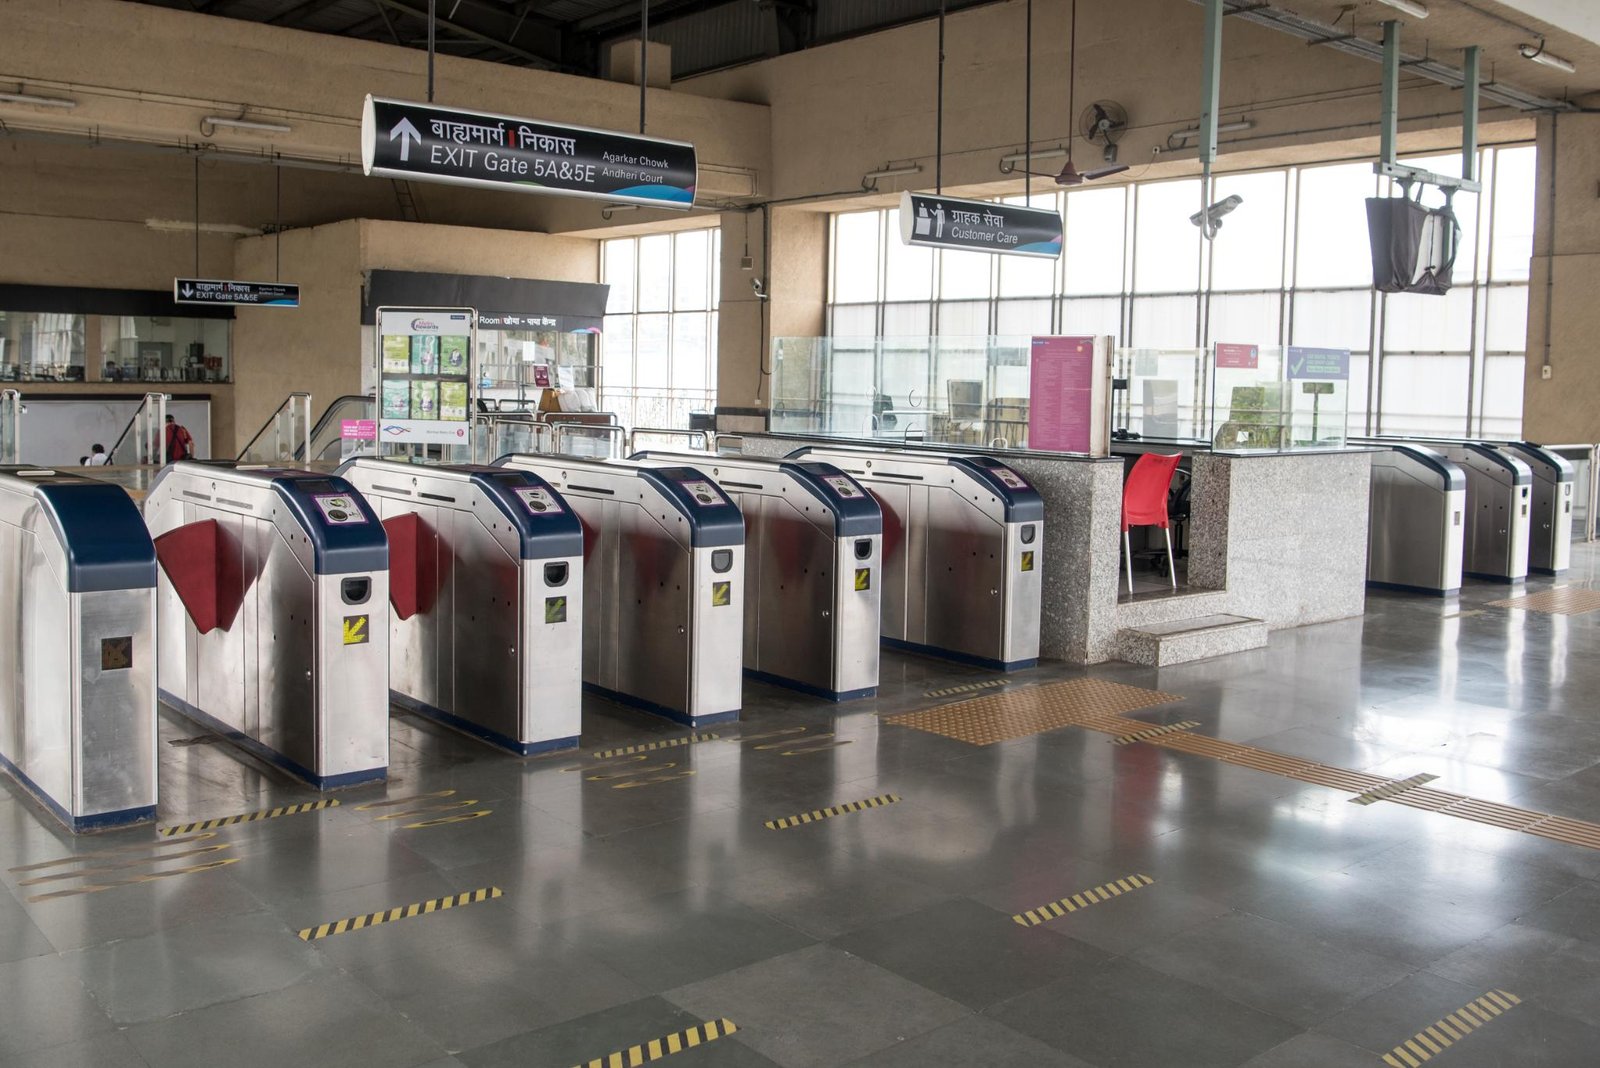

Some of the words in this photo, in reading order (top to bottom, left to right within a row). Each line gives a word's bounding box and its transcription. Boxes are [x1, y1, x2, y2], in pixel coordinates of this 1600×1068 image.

[430, 118, 505, 146] बाह्यमार्ग
[518, 125, 576, 156] निकास
[430, 145, 478, 168] EXIT
[484, 152, 528, 175] Gate
[534, 158, 596, 183] 5A&5E
[602, 151, 638, 164] Agarkar
[639, 156, 669, 169] Chowk
[602, 167, 637, 180] Andheri
[639, 171, 663, 183] Court
[951, 209, 980, 226] ग्राहक
[983, 209, 1004, 228] सेवा
[951, 226, 994, 242] Customer
[997, 232, 1018, 244] Care
[196, 291, 213, 299] EXIT
[215, 292, 232, 300] Gate
[233, 293, 259, 301] 5A&5E
[479, 316, 500, 324] Room
